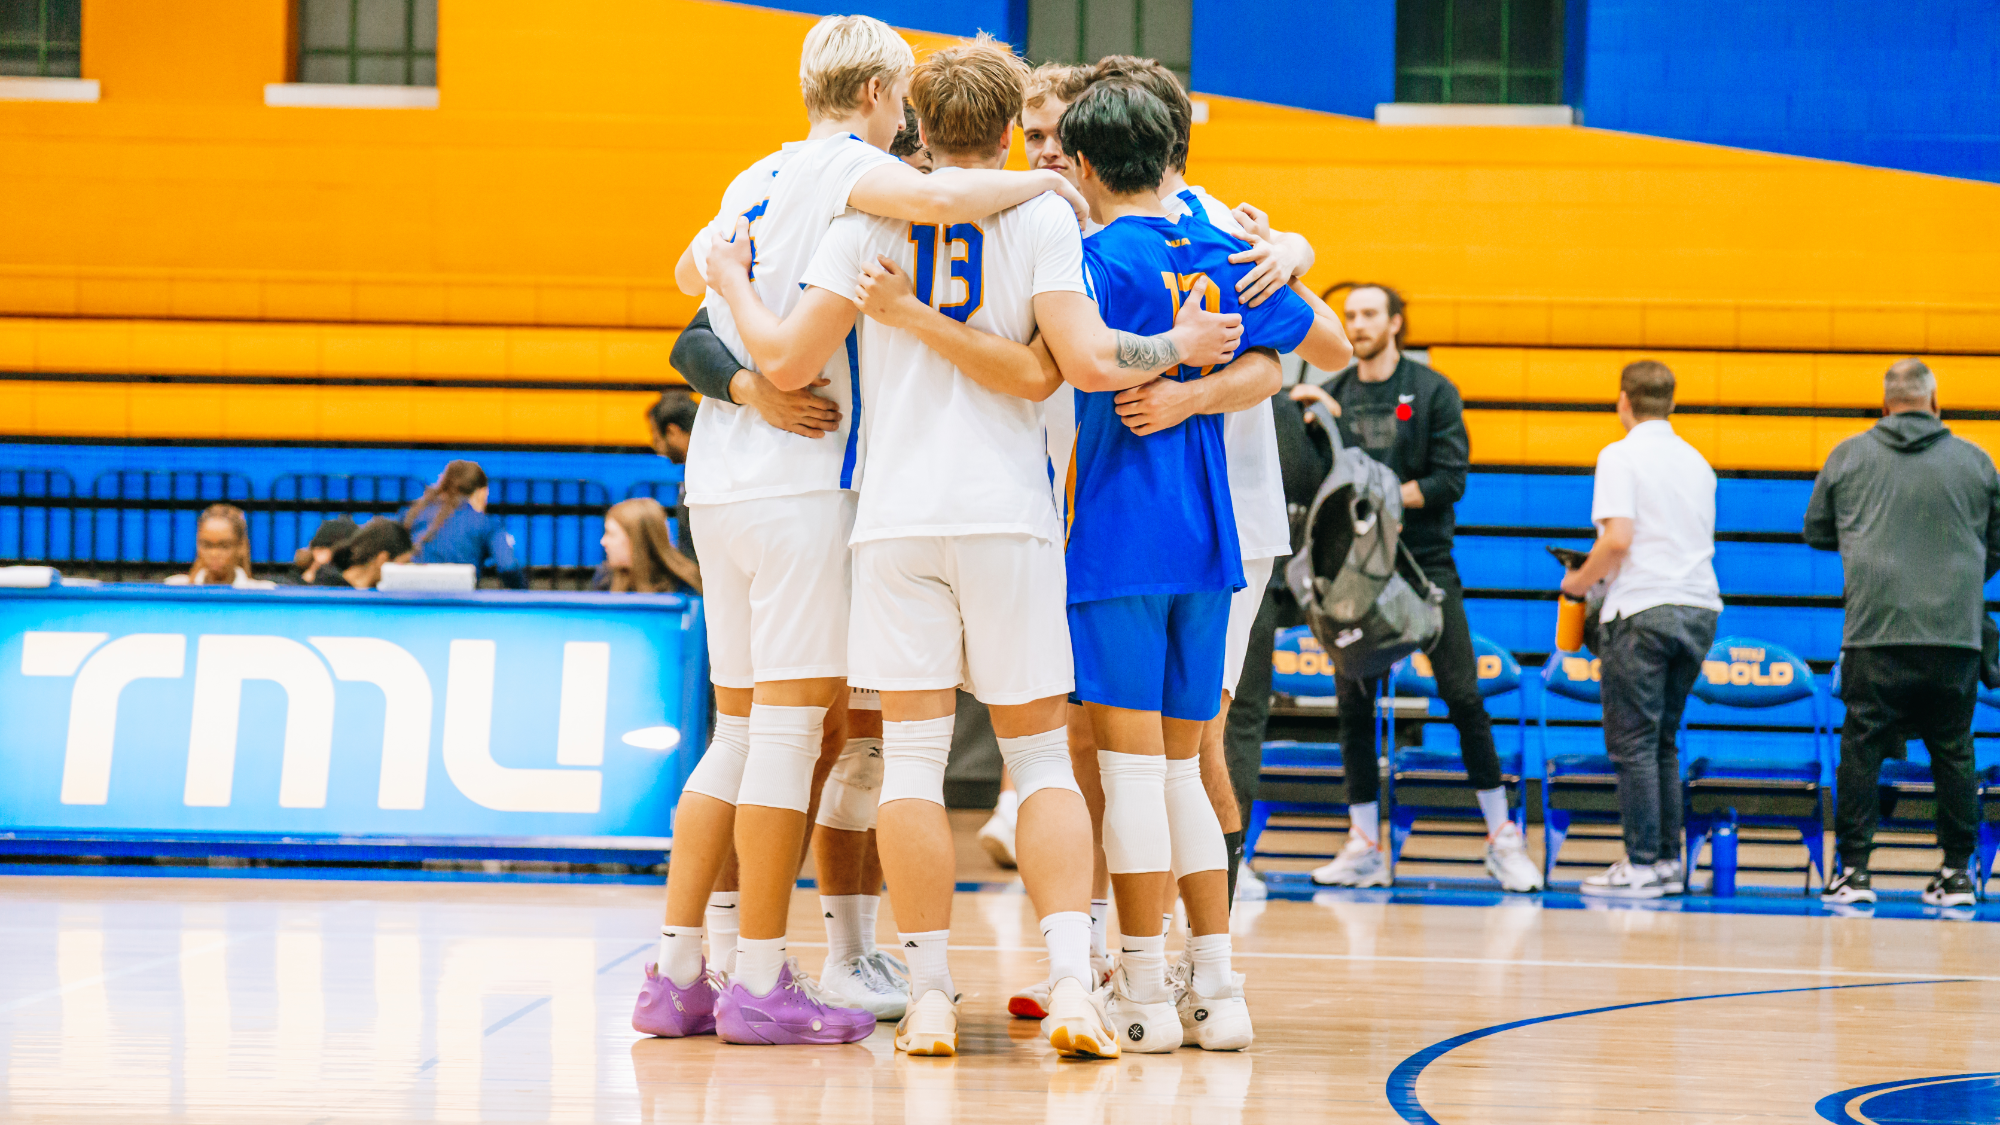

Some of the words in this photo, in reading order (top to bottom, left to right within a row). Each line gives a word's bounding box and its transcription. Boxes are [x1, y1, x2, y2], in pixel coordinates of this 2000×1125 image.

[908, 221, 985, 324] 13
[1272, 650, 1336, 676] BOL
[1702, 660, 1794, 686] BOLD
[21, 631, 610, 813] TMU
